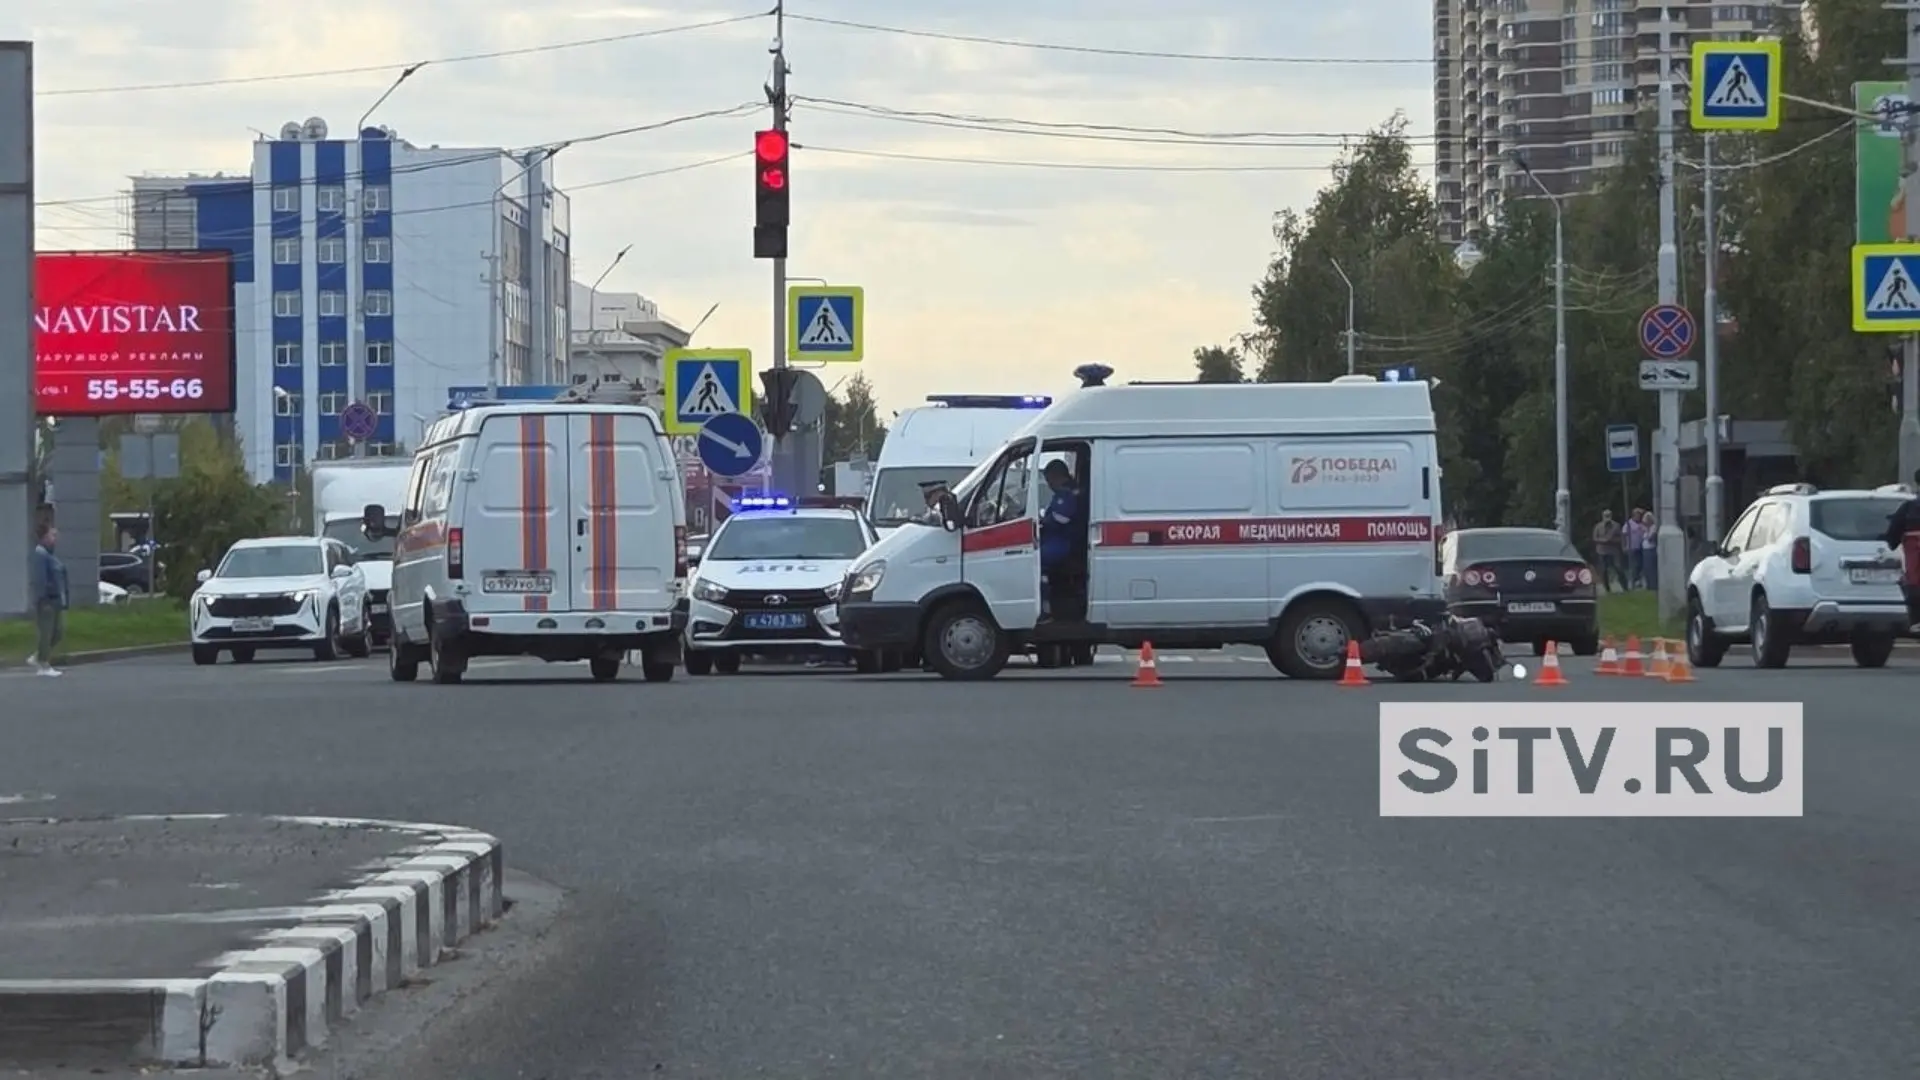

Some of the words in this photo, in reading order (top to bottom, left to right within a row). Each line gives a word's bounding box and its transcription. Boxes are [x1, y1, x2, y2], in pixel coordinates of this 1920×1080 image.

[35, 305, 202, 333] NAVISTAR
[88, 378, 203, 400] 55-55-66
[1167, 525, 1221, 540] СКОРАЯ
[1238, 523, 1341, 541] МЕДИЦИНСКАЯ
[1367, 521, 1428, 538] ПОМОЩЬ
[736, 564, 820, 575] ДПС
